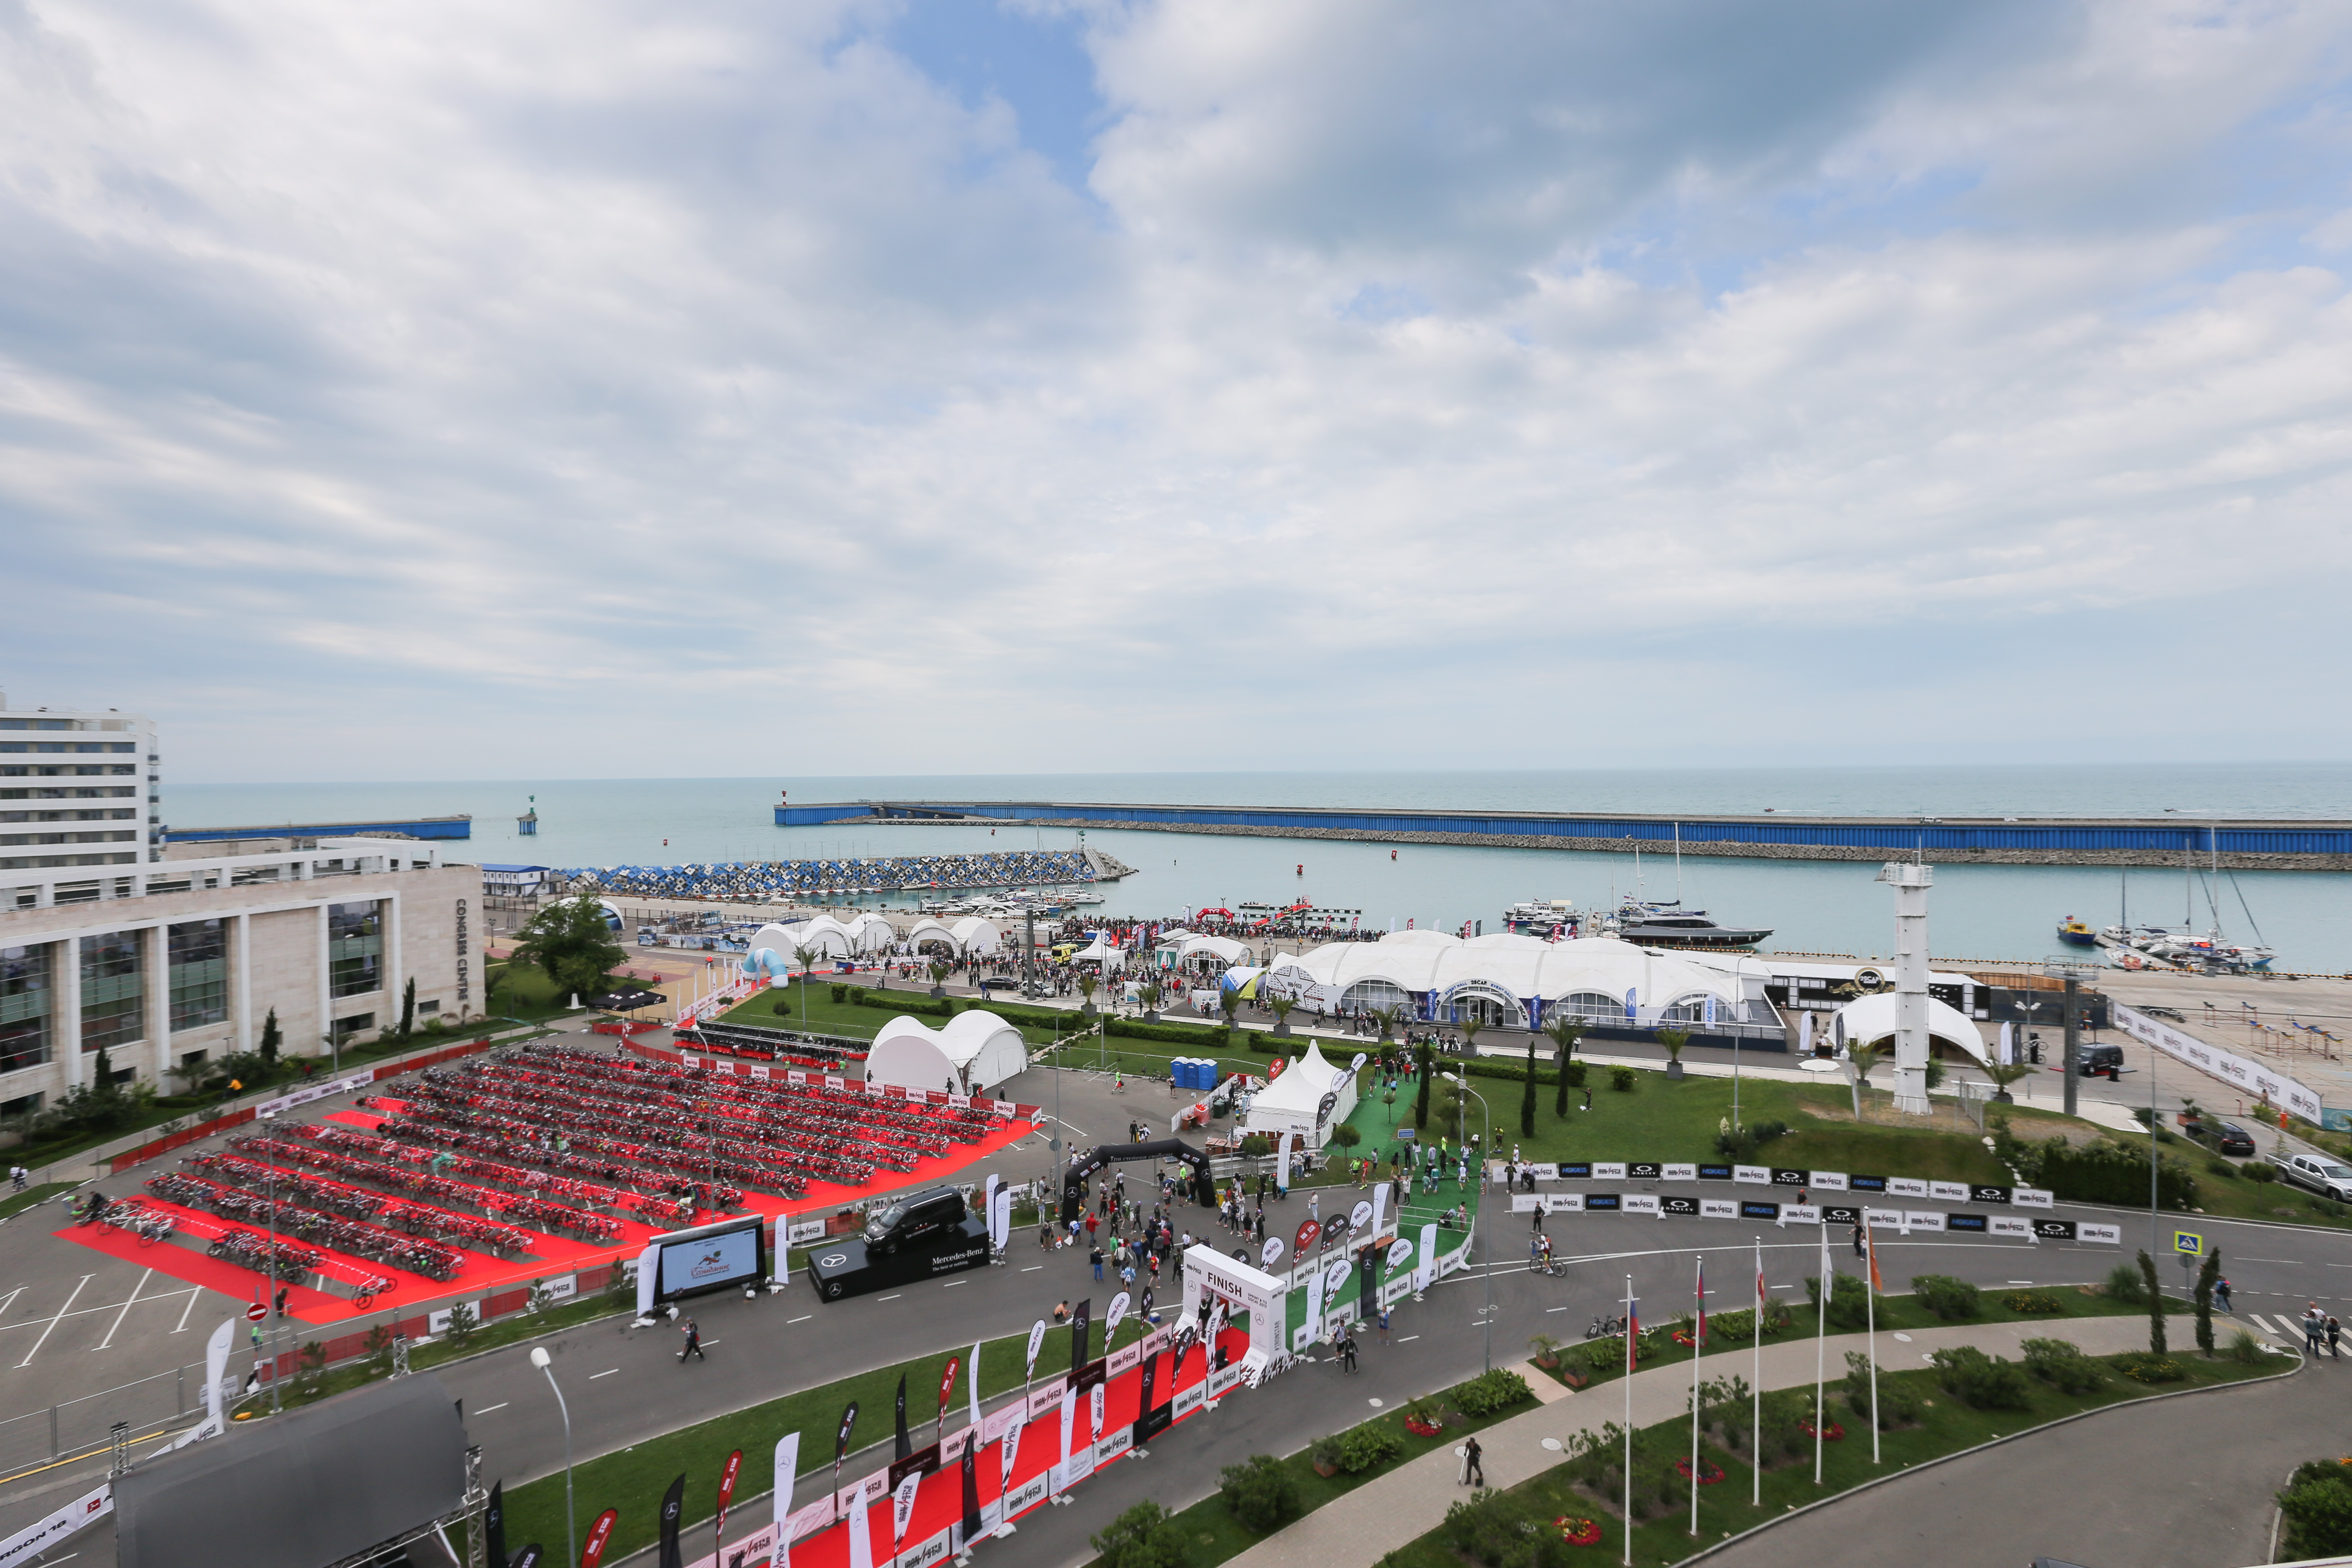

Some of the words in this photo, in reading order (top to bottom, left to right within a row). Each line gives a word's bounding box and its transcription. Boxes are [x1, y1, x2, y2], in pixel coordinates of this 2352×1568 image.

[456, 898, 467, 956] CONGRESS
[457, 958, 468, 1001] CENTRE
[1445, 985, 1456, 995] EVENT
[1491, 983, 1504, 992] EVENT
[1504, 990, 1513, 1000] HALL
[933, 1248, 983, 1265] Mercedes-Benz
[691, 1264, 730, 1277] Созидание
[1208, 1272, 1242, 1298] FINISH
[1248, 1293, 1259, 1302] SPRINT
[1248, 1297, 1259, 1306] SOCHI
[0, 1531, 46, 1561] RGON
[48, 1520, 67, 1532] 18
